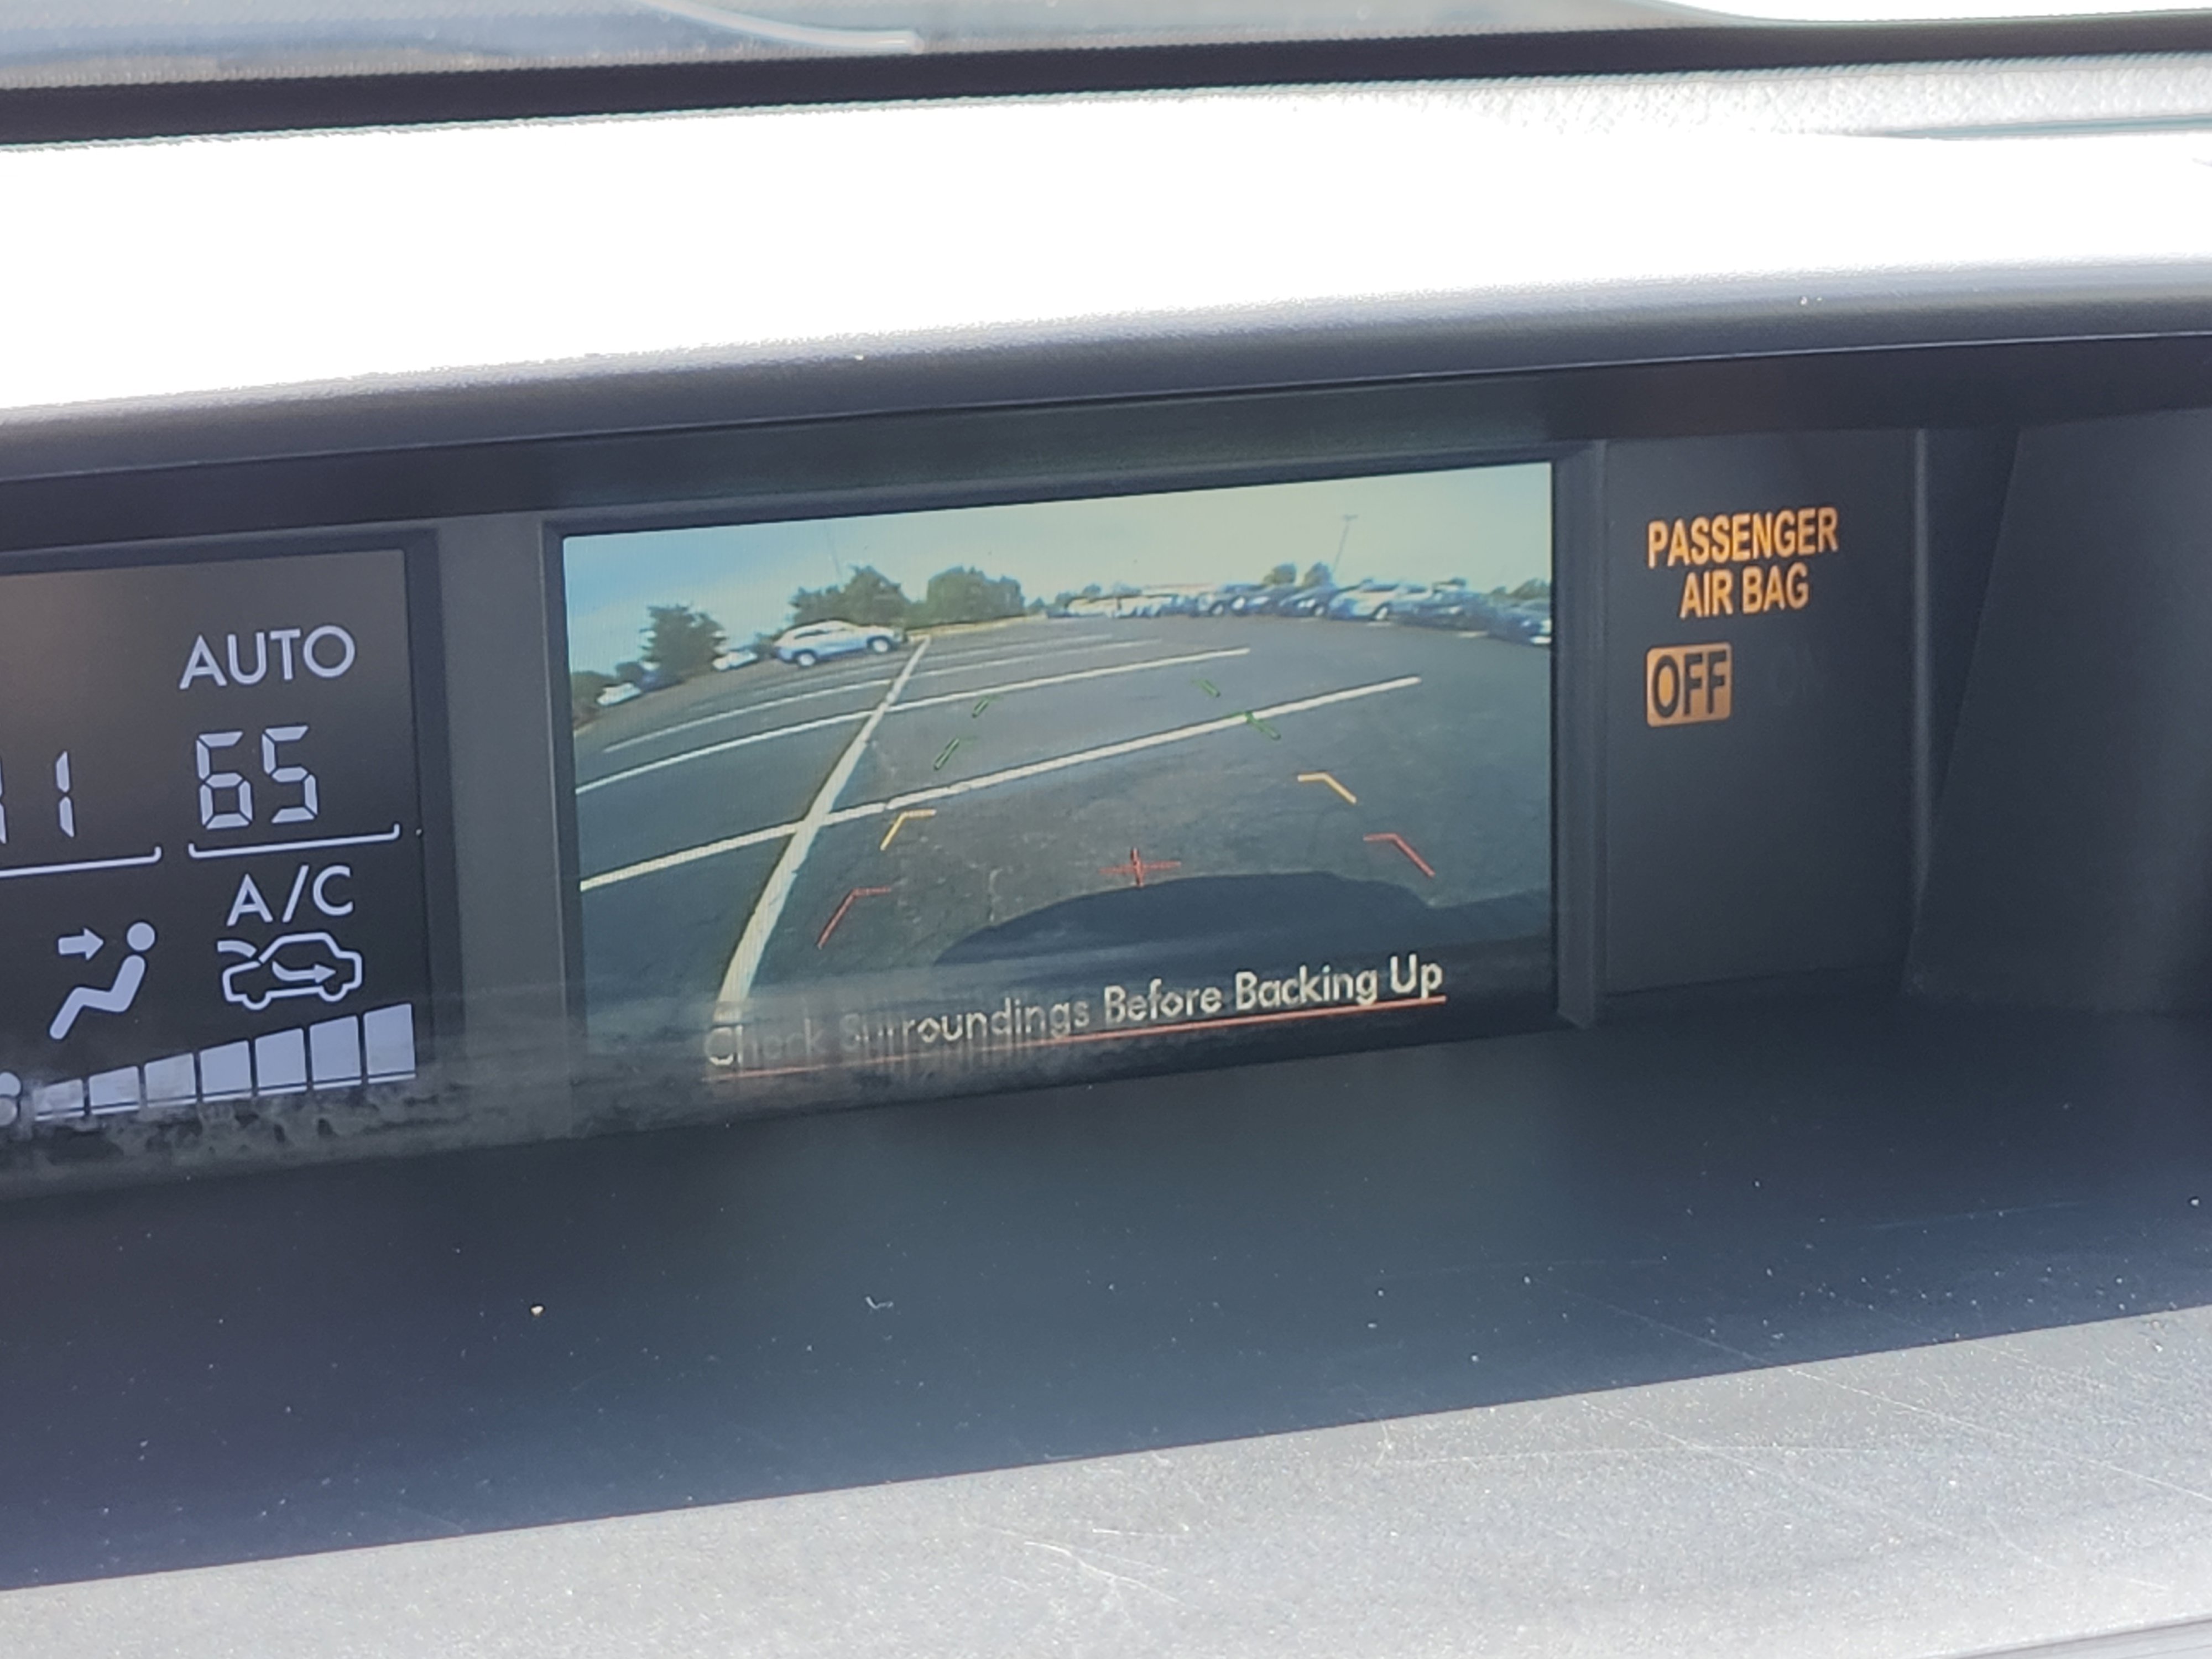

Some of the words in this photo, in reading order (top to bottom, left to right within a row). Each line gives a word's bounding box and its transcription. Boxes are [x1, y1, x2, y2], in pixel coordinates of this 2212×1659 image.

[1647, 507, 1838, 569] PASSENGER
[1679, 568, 1733, 619] AIR
[1743, 562, 1809, 615] BAG
[180, 624, 355, 690] AUTO
[1652, 650, 1727, 718] OFF
[196, 725, 319, 829] 65
[227, 865, 354, 926] A/C
[1104, 978, 1222, 1024] Before
[1235, 965, 1378, 1005] Backing
[1389, 954, 1442, 999] Up
